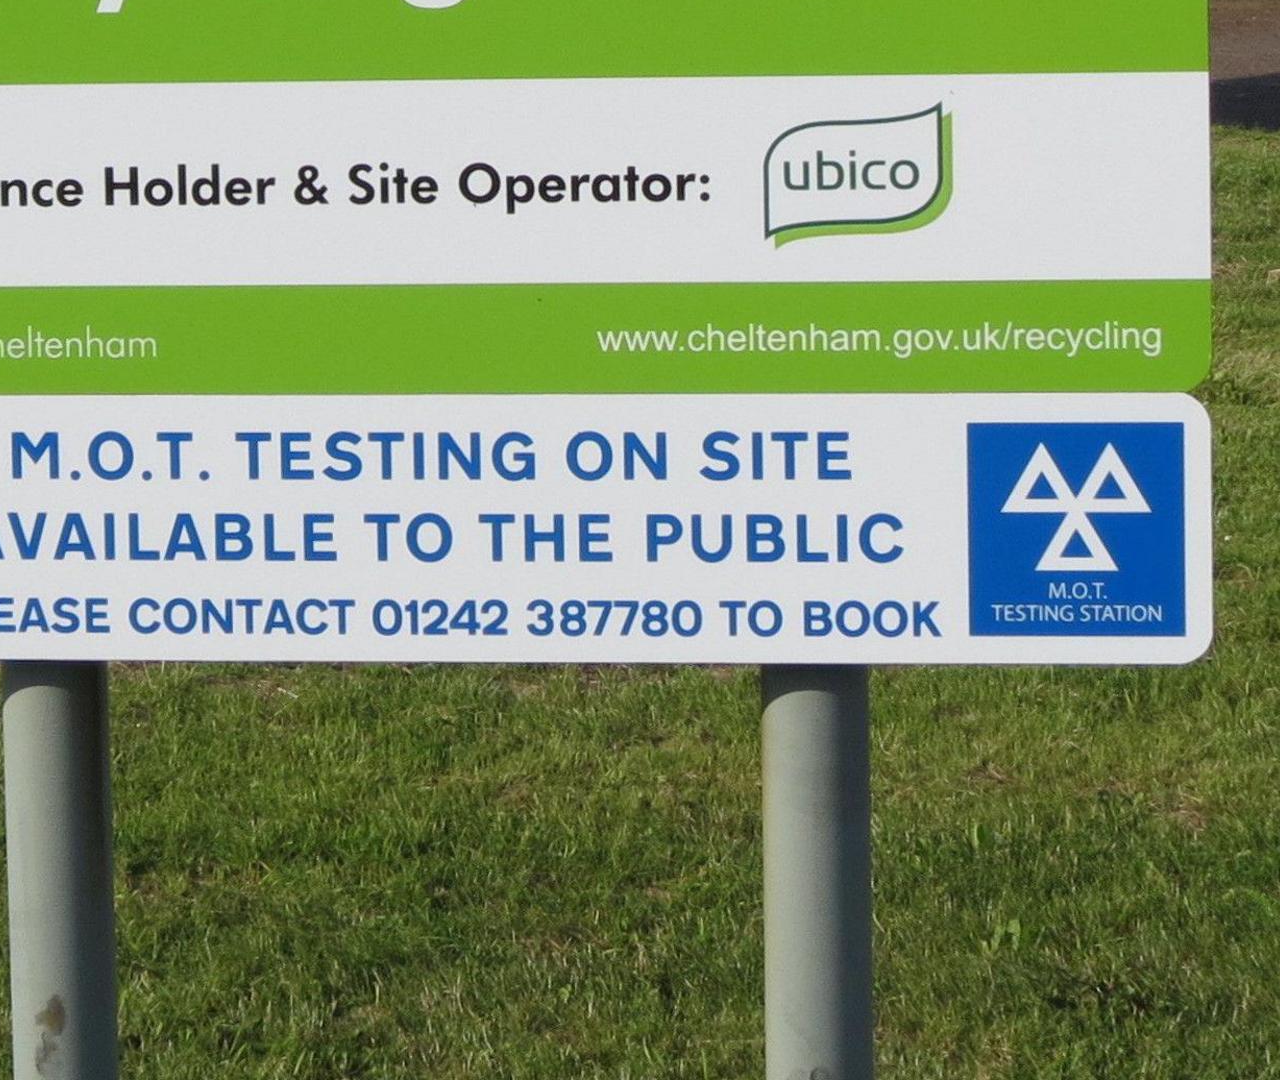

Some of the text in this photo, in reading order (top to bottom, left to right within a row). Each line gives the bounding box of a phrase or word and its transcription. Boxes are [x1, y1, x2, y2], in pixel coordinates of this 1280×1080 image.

[105, 164, 275, 206] Holder
[294, 165, 328, 205] &
[349, 163, 438, 205] Site
[459, 163, 709, 214] Operator:
[783, 148, 920, 193] ubico
[596, 321, 1163, 360] www.cheltenham.gov.uk/recycling
[12, 431, 851, 481] M.O.T. TESTING ON SITE
[364, 513, 452, 562] TO
[479, 514, 612, 562] THE
[647, 513, 903, 563] PUBLIC
[1049, 582, 1107, 599] M.O.T.
[129, 598, 355, 635] CONTACT
[373, 599, 508, 636] 01242
[527, 600, 702, 637] 387780
[720, 600, 783, 637] TO
[804, 601, 941, 637] BOOK
[991, 604, 1162, 622] TESTING STATION
